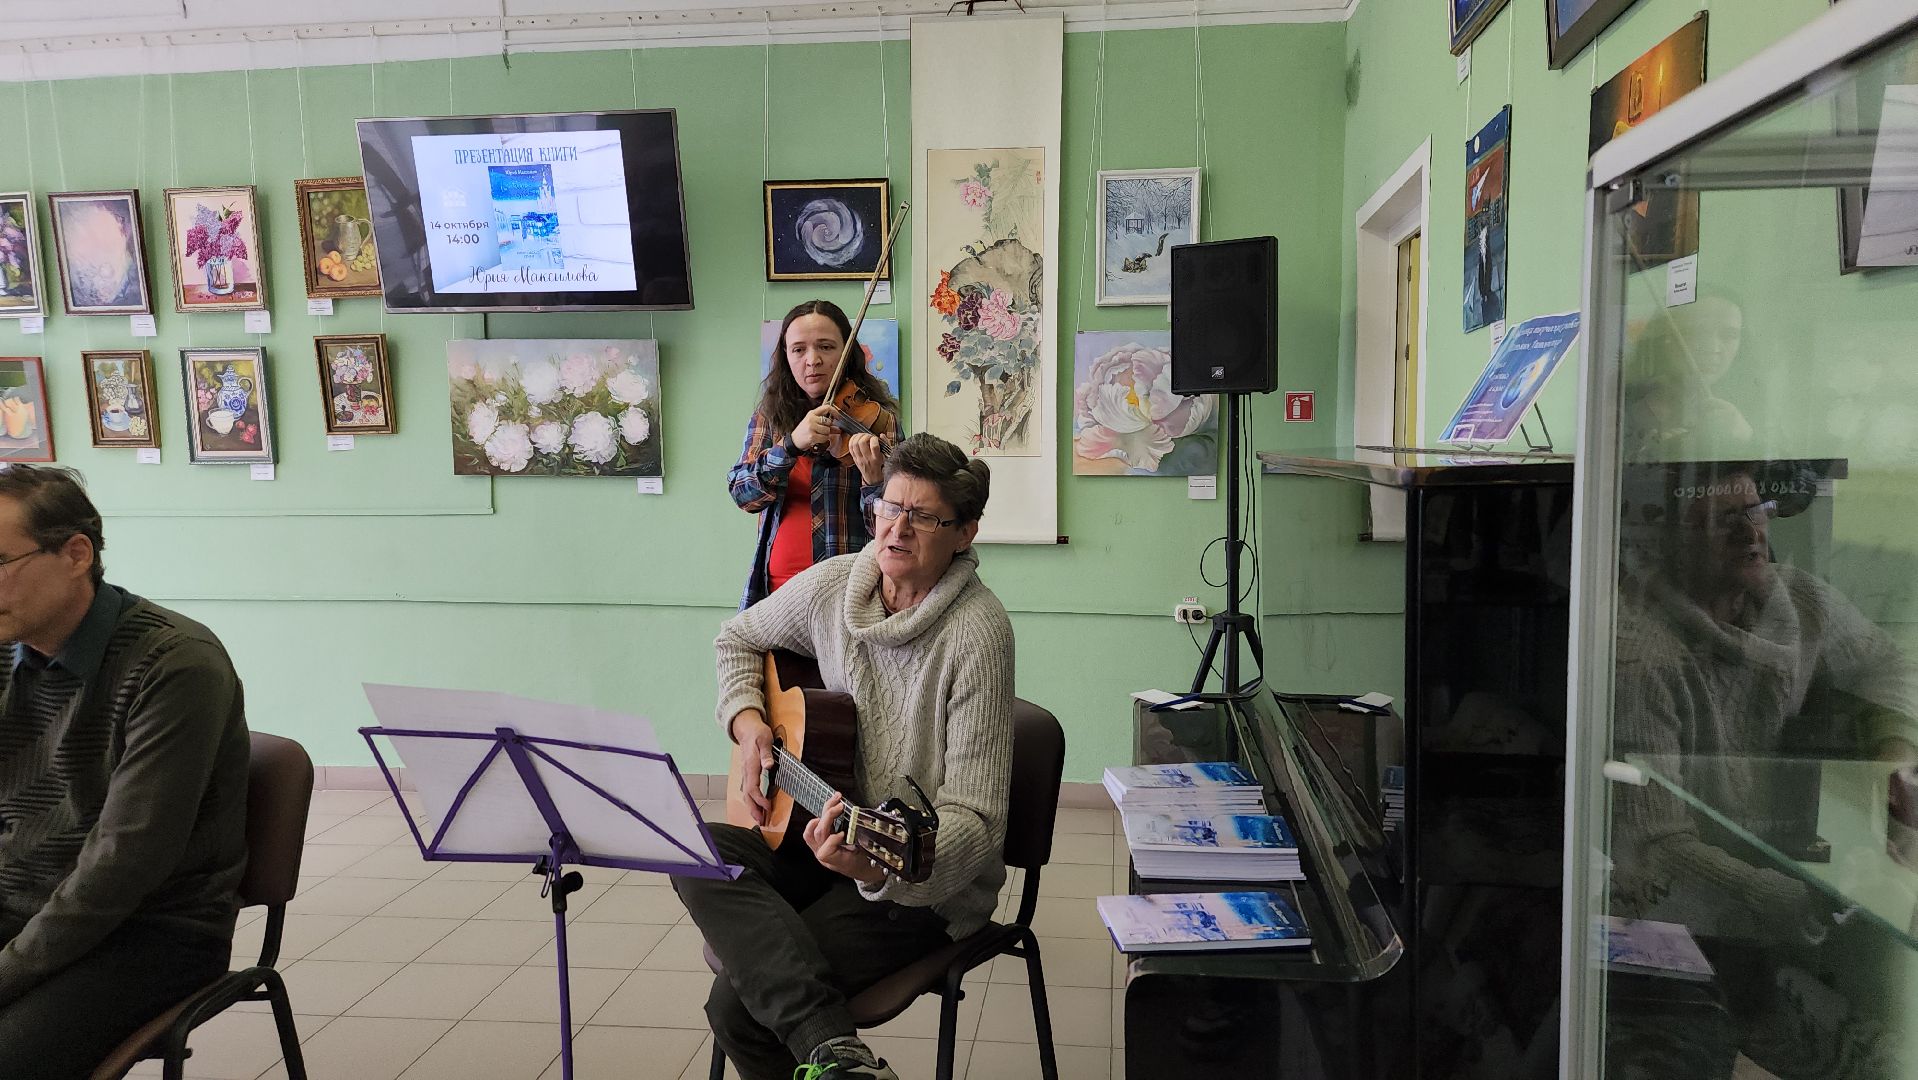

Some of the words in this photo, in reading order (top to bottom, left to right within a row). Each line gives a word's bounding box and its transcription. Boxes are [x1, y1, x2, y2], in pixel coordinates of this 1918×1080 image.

[454, 147, 533, 165] ПРЕЗЕНТАЦИЯ
[539, 146, 578, 162] КНИГИ
[430, 220, 442, 229] 14
[443, 219, 489, 231] октября
[446, 233, 480, 245] 14:00
[469, 265, 509, 291] Юрия
[513, 263, 600, 285] Максимова
